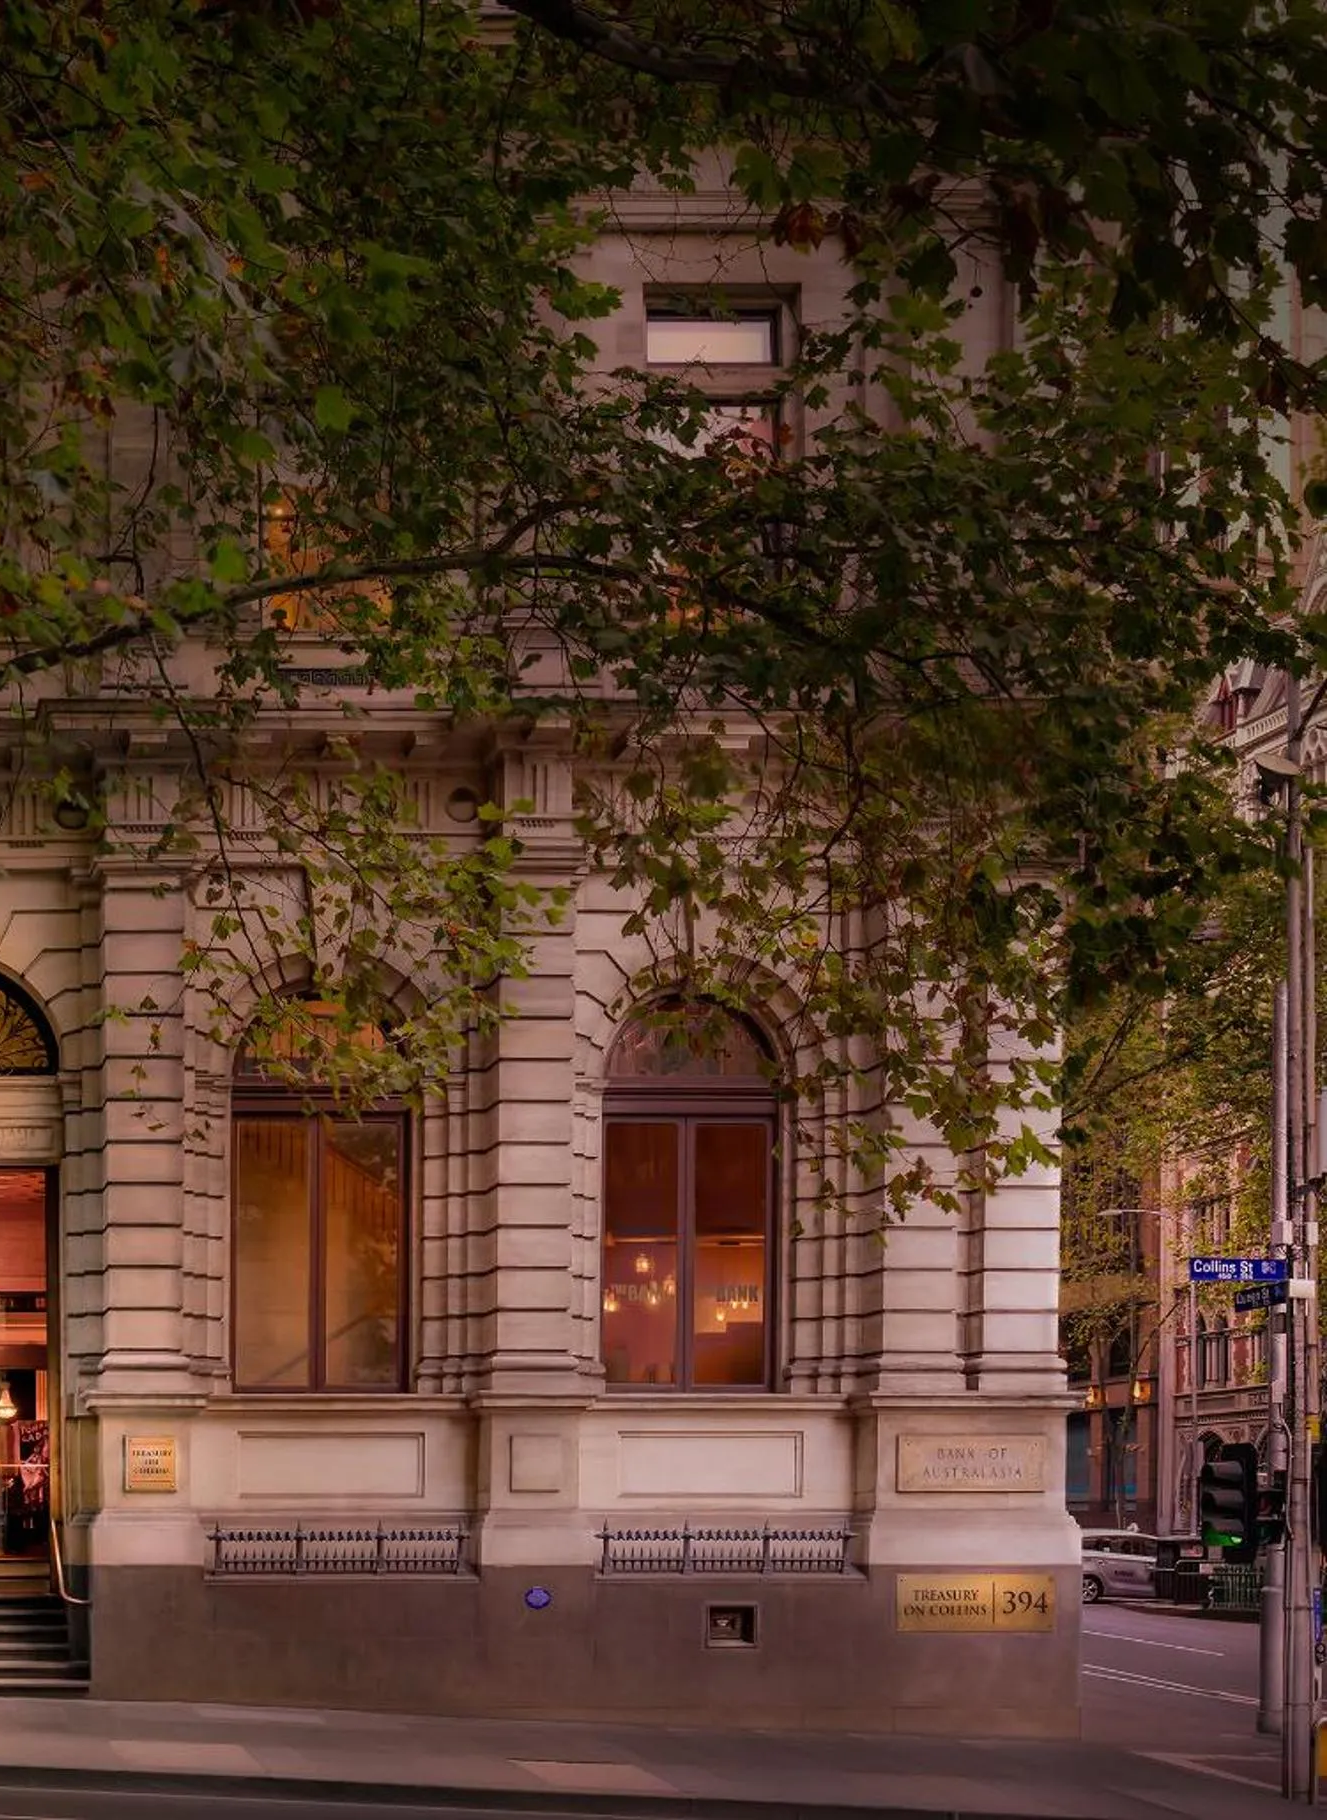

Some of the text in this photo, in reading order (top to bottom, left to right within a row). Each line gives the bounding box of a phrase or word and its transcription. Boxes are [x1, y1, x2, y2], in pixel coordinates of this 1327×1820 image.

[1193, 1259, 1253, 1274] Collins St
[936, 1448, 1008, 1460] BANK OF
[922, 1467, 1023, 1479] AUSTRALASIA
[913, 1589, 980, 1602] TREASURY
[1001, 1590, 1049, 1614] 394
[903, 1605, 987, 1616] ON COLLINS
